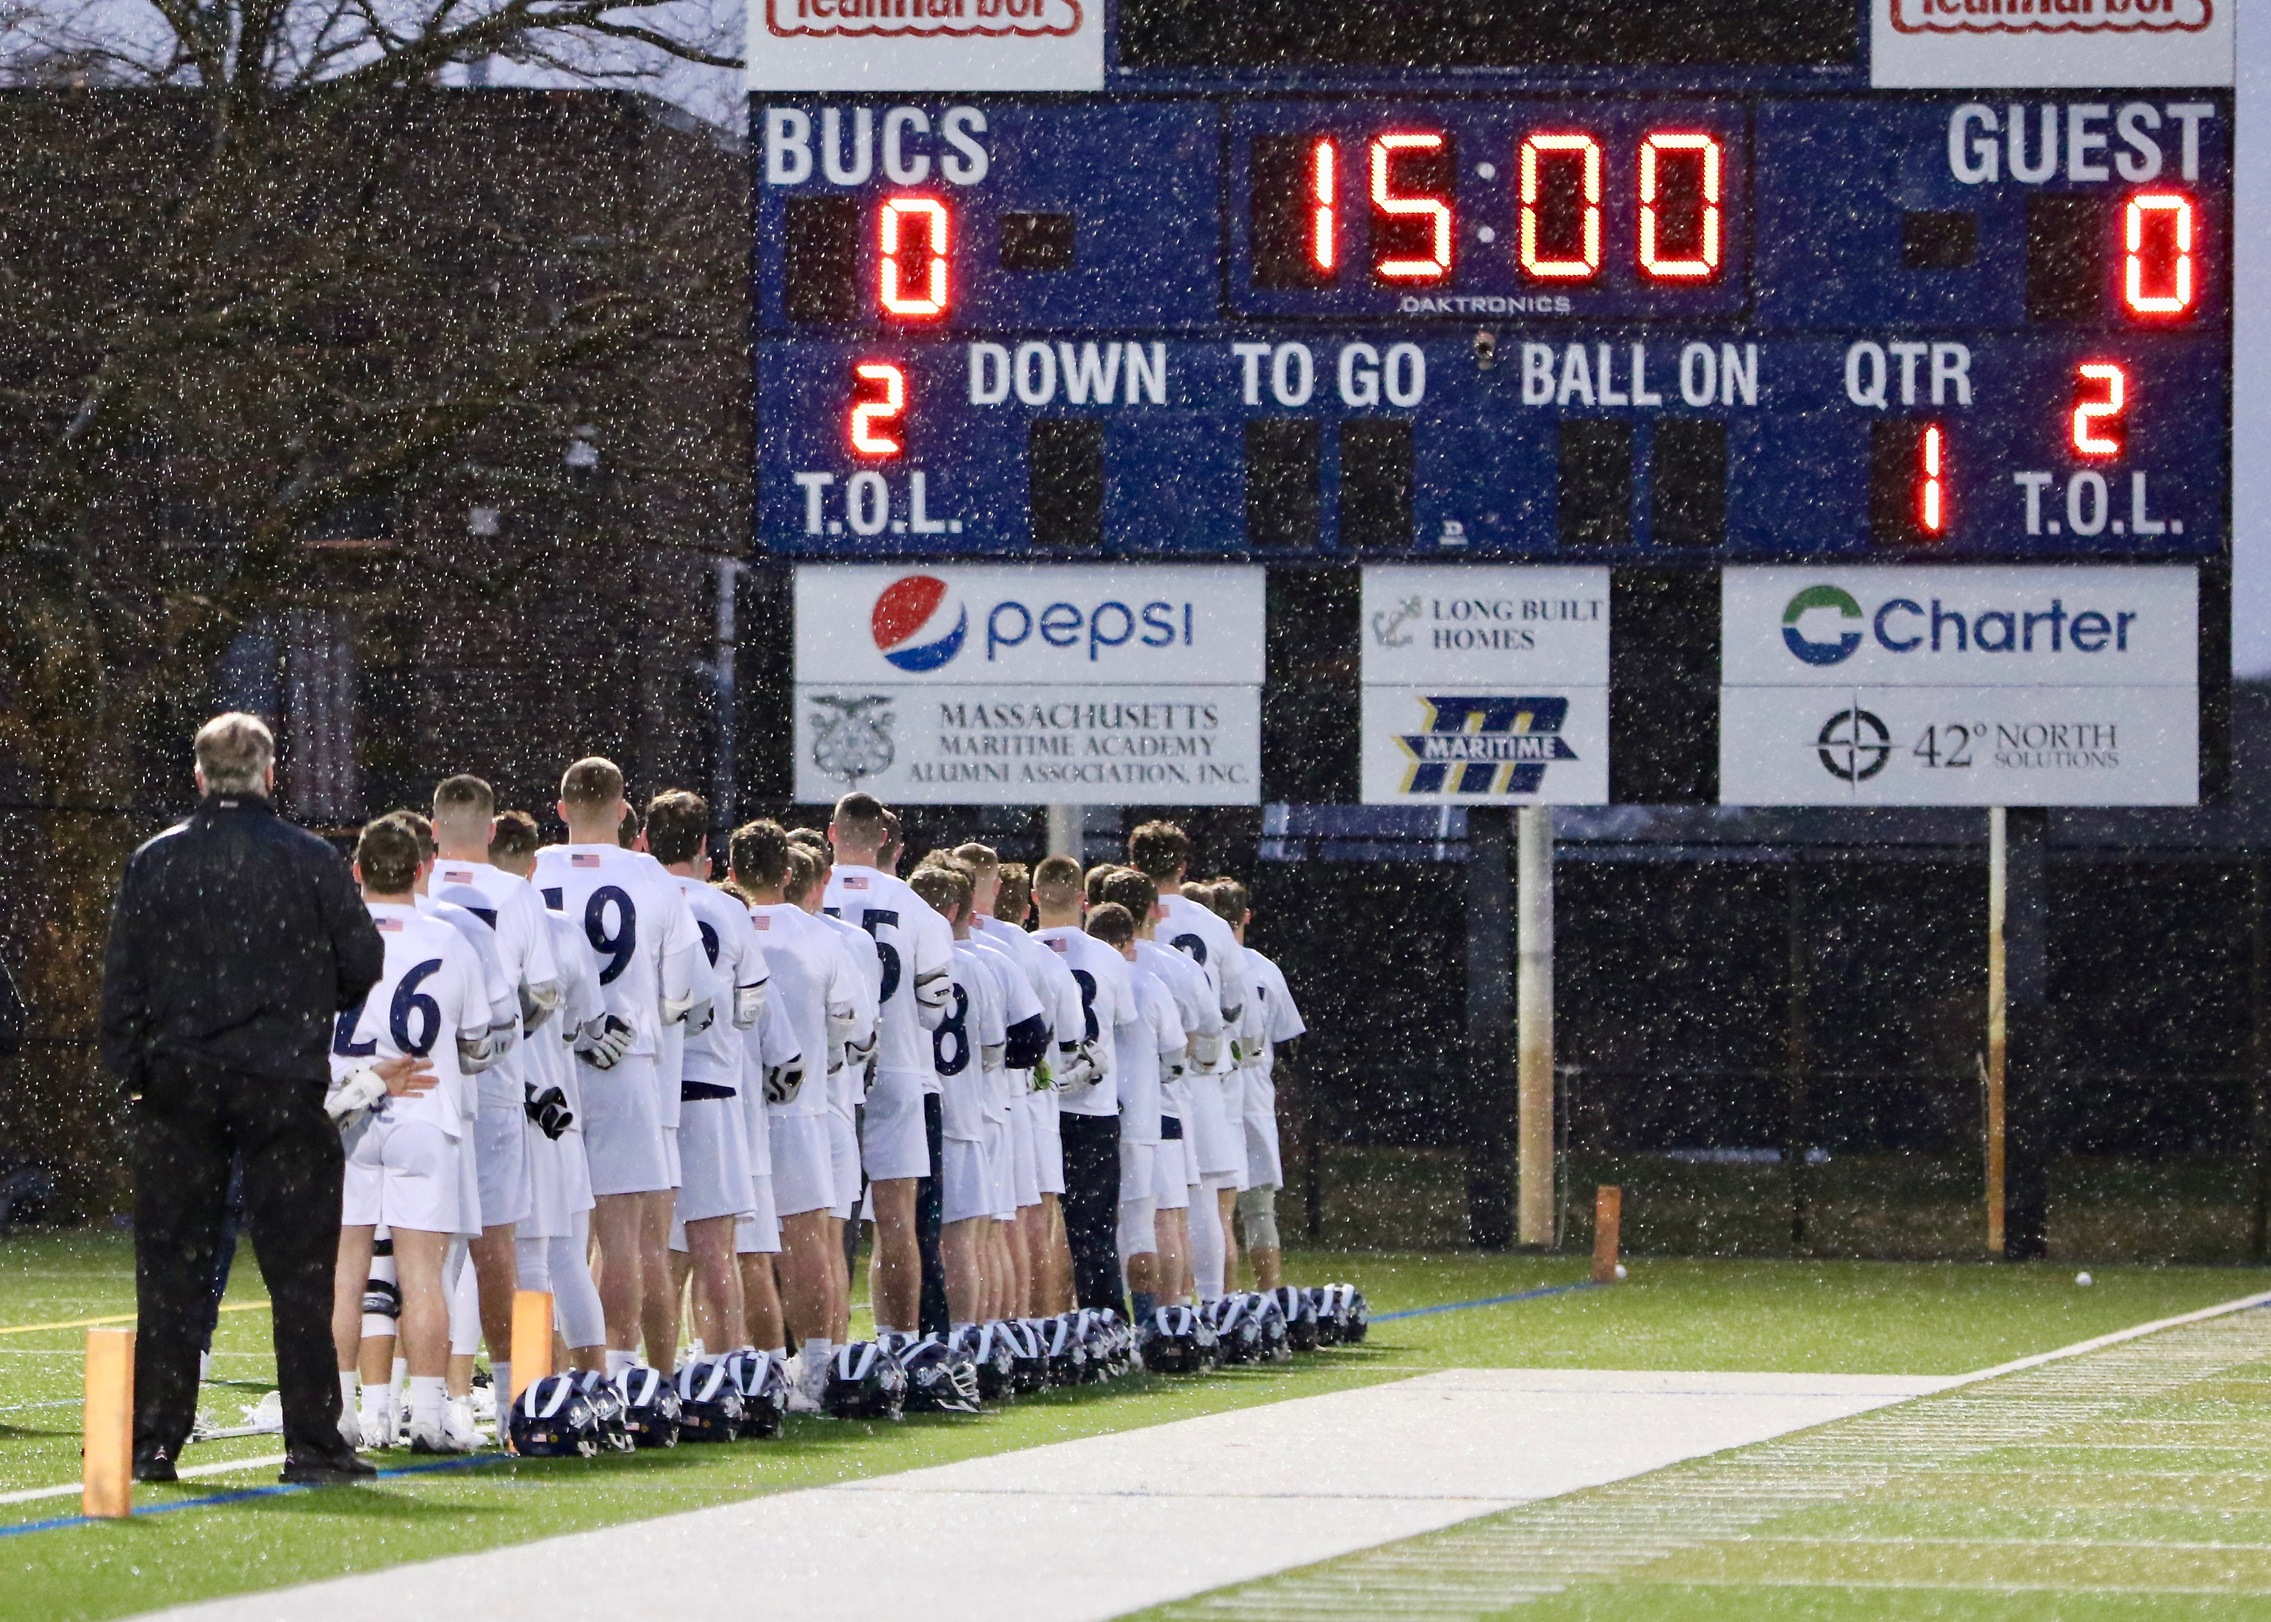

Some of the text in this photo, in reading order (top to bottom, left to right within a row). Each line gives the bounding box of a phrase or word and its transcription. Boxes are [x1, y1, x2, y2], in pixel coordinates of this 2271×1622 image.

[763, 105, 990, 186] BUCS
[1948, 102, 2215, 184] GUEST
[1312, 132, 1722, 278] 15:00
[879, 197, 949, 316] 0
[2125, 194, 2193, 314] 0
[1400, 295, 1572, 313] DAKTRONICS
[968, 342, 1167, 406] DOWN
[1233, 342, 1427, 407] TO GO
[1521, 342, 1758, 406] BALL ON
[1844, 341, 1974, 410] QTR
[850, 364, 904, 455] 2
[2071, 363, 2125, 455] 2
[793, 471, 963, 536] T.O.L.
[2014, 472, 2184, 536] T.O.L.
[987, 601, 1194, 662] pepsi
[1432, 599, 1604, 622] LONG BUILT
[1432, 629, 1536, 650] HOMES
[1873, 598, 2137, 653] Charter
[940, 702, 1219, 731] MASSACHUSETTS
[940, 735, 1217, 757] MARITIME ACADEMY
[1423, 736, 1556, 760] MARITIME
[1996, 724, 2118, 749] NORTH
[908, 762, 1011, 784] ALUMNI
[1197, 762, 1249, 785] INC.
[1994, 751, 2119, 769] SOLUTIONS
